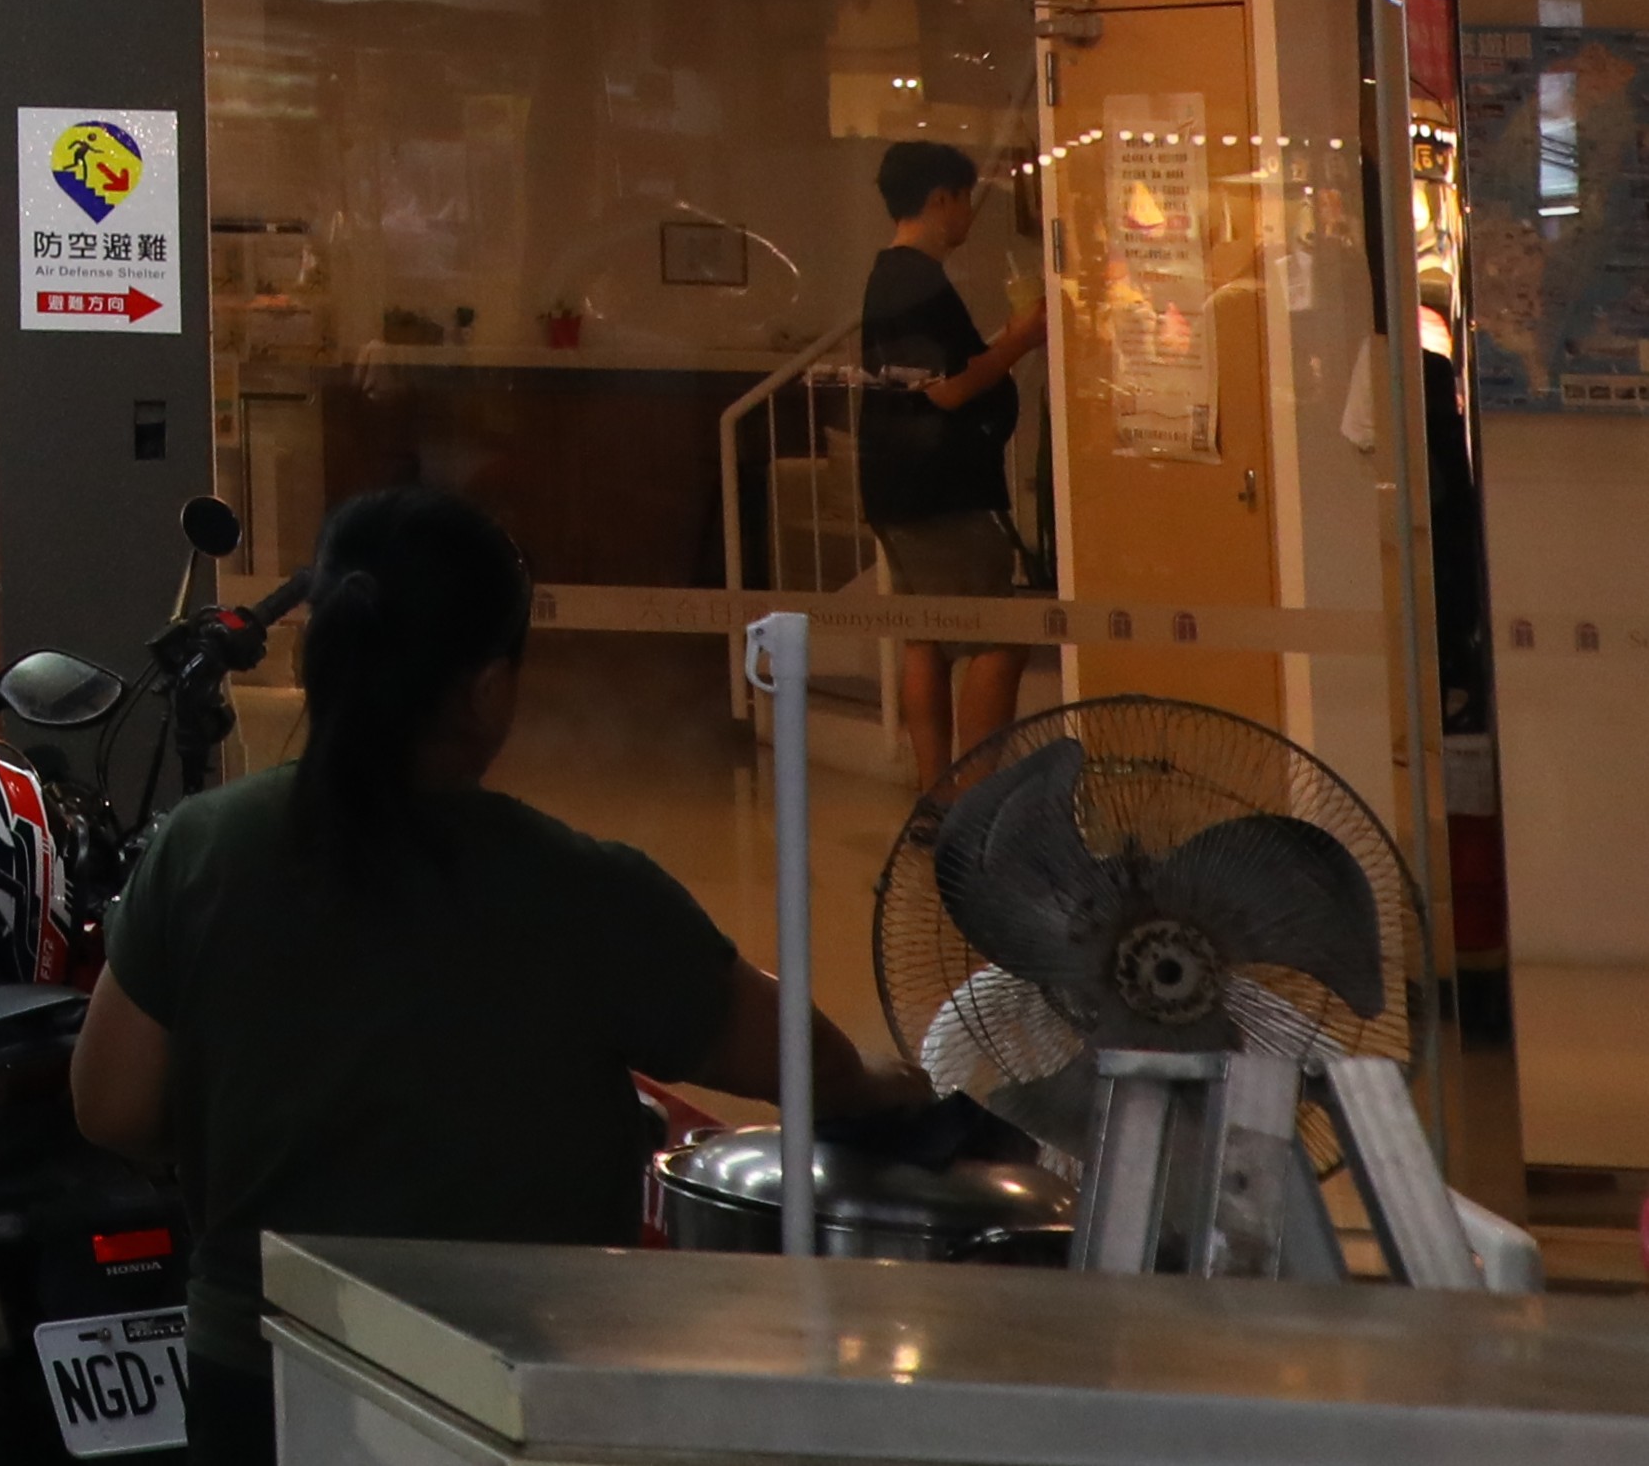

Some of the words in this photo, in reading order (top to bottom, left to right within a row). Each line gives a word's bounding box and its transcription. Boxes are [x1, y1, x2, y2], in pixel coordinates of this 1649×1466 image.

[33, 230, 168, 263] 防空避難
[36, 267, 56, 279] Air
[59, 267, 114, 279] Defense
[118, 268, 167, 280] Shelter
[46, 295, 126, 313] 避難方向
[807, 606, 916, 633] Sunnyside
[923, 609, 983, 632] Hotel
[104, 1261, 164, 1277] HONDA
